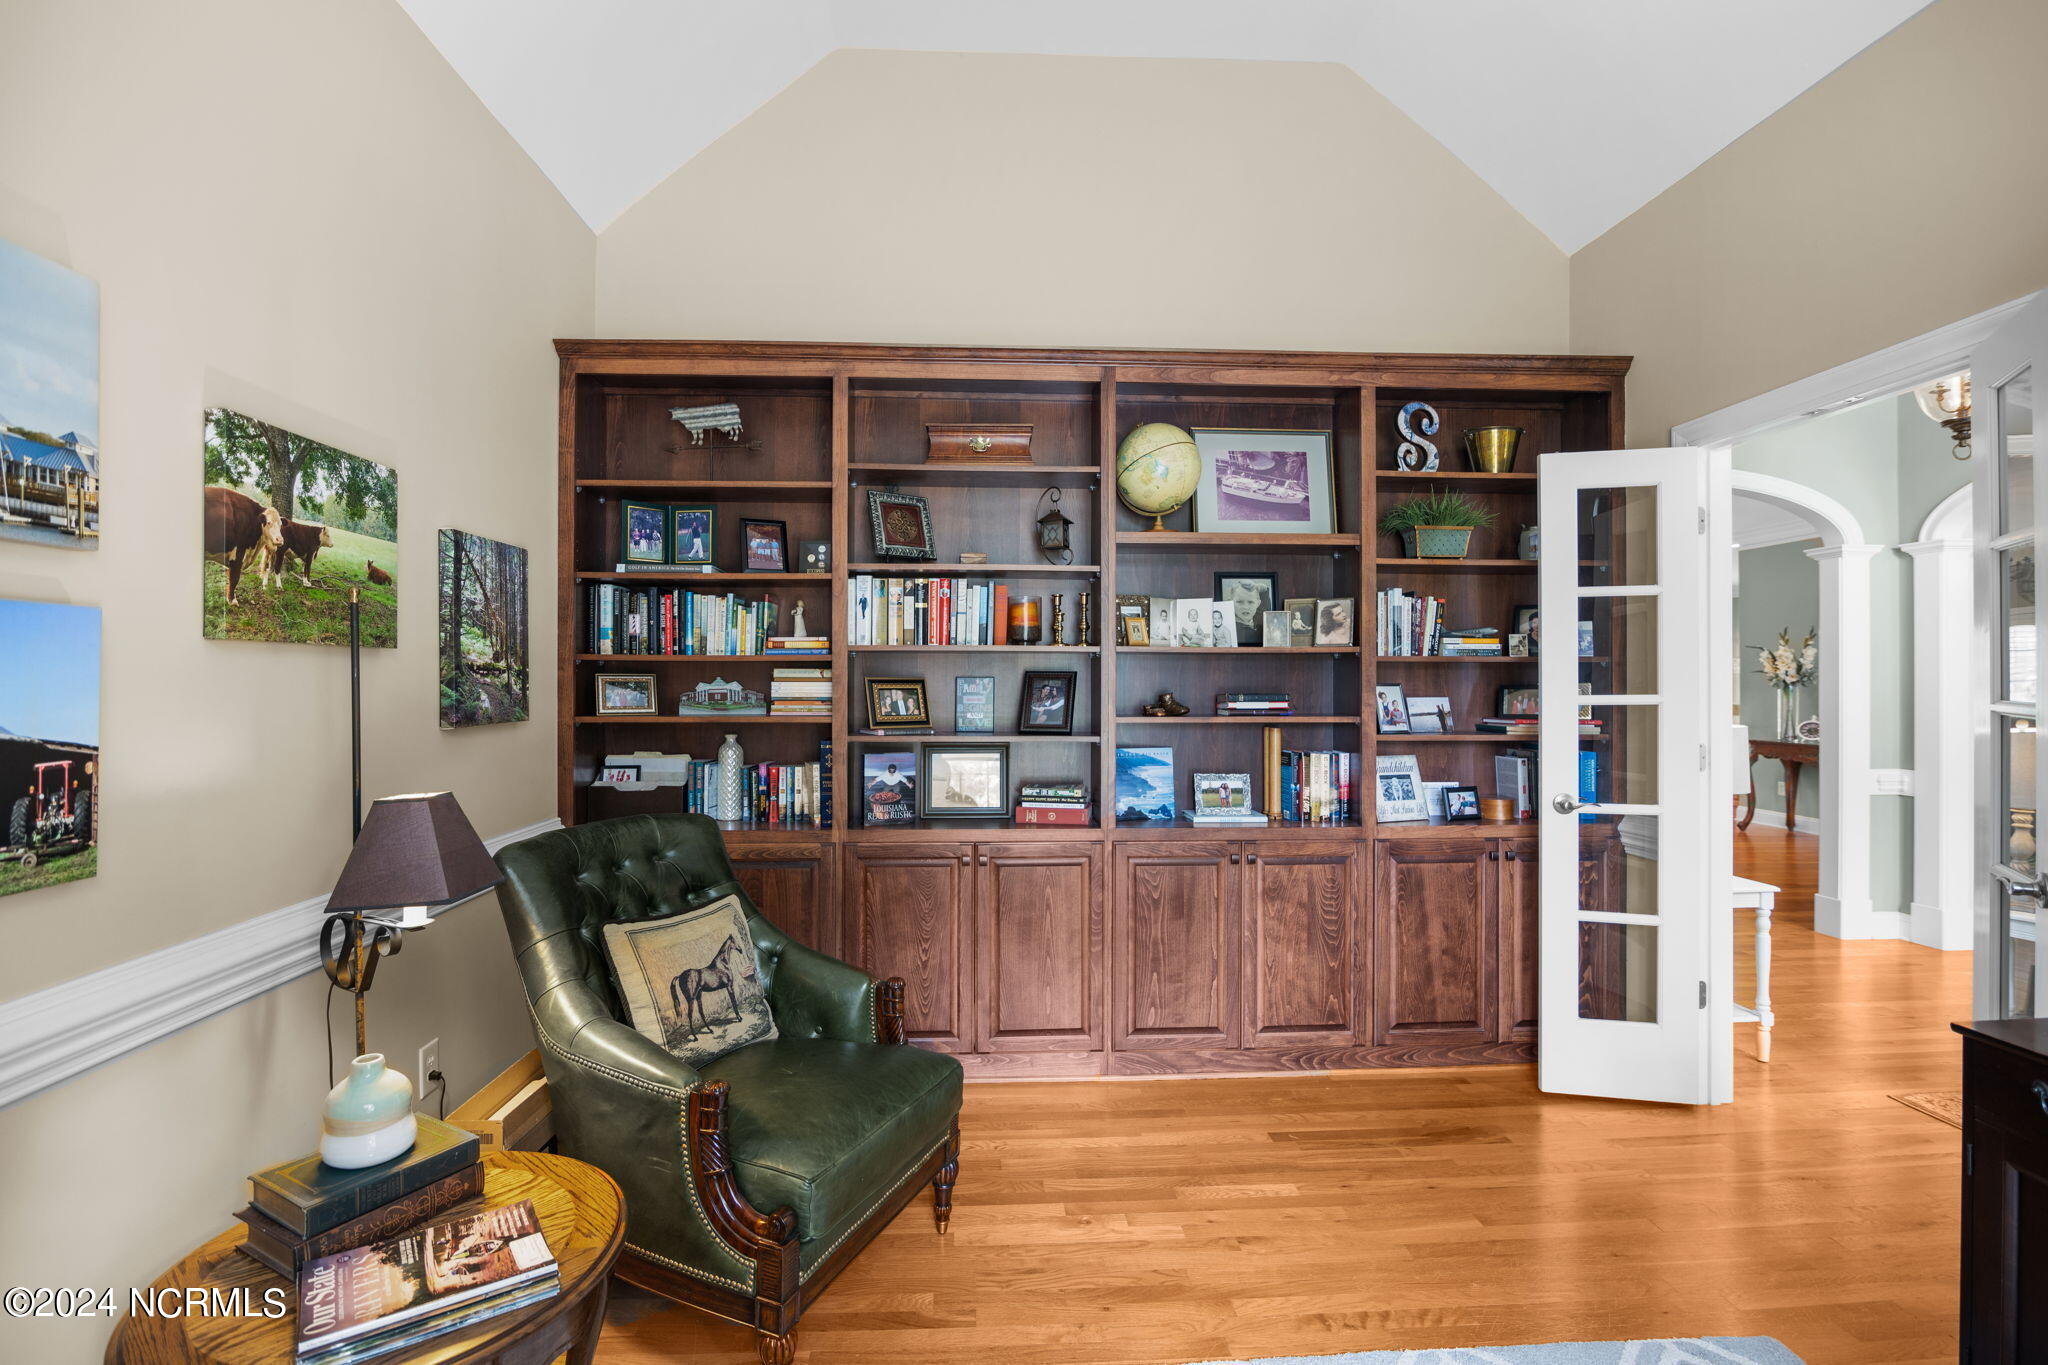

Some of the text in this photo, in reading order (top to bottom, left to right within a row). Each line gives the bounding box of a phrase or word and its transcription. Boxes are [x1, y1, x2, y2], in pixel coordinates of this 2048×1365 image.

[873, 804, 907, 813] LOUISIANA
[890, 810, 912, 819] RUSTIC
[303, 1264, 336, 1335] Our State
[352, 1253, 383, 1320] RIVERS
